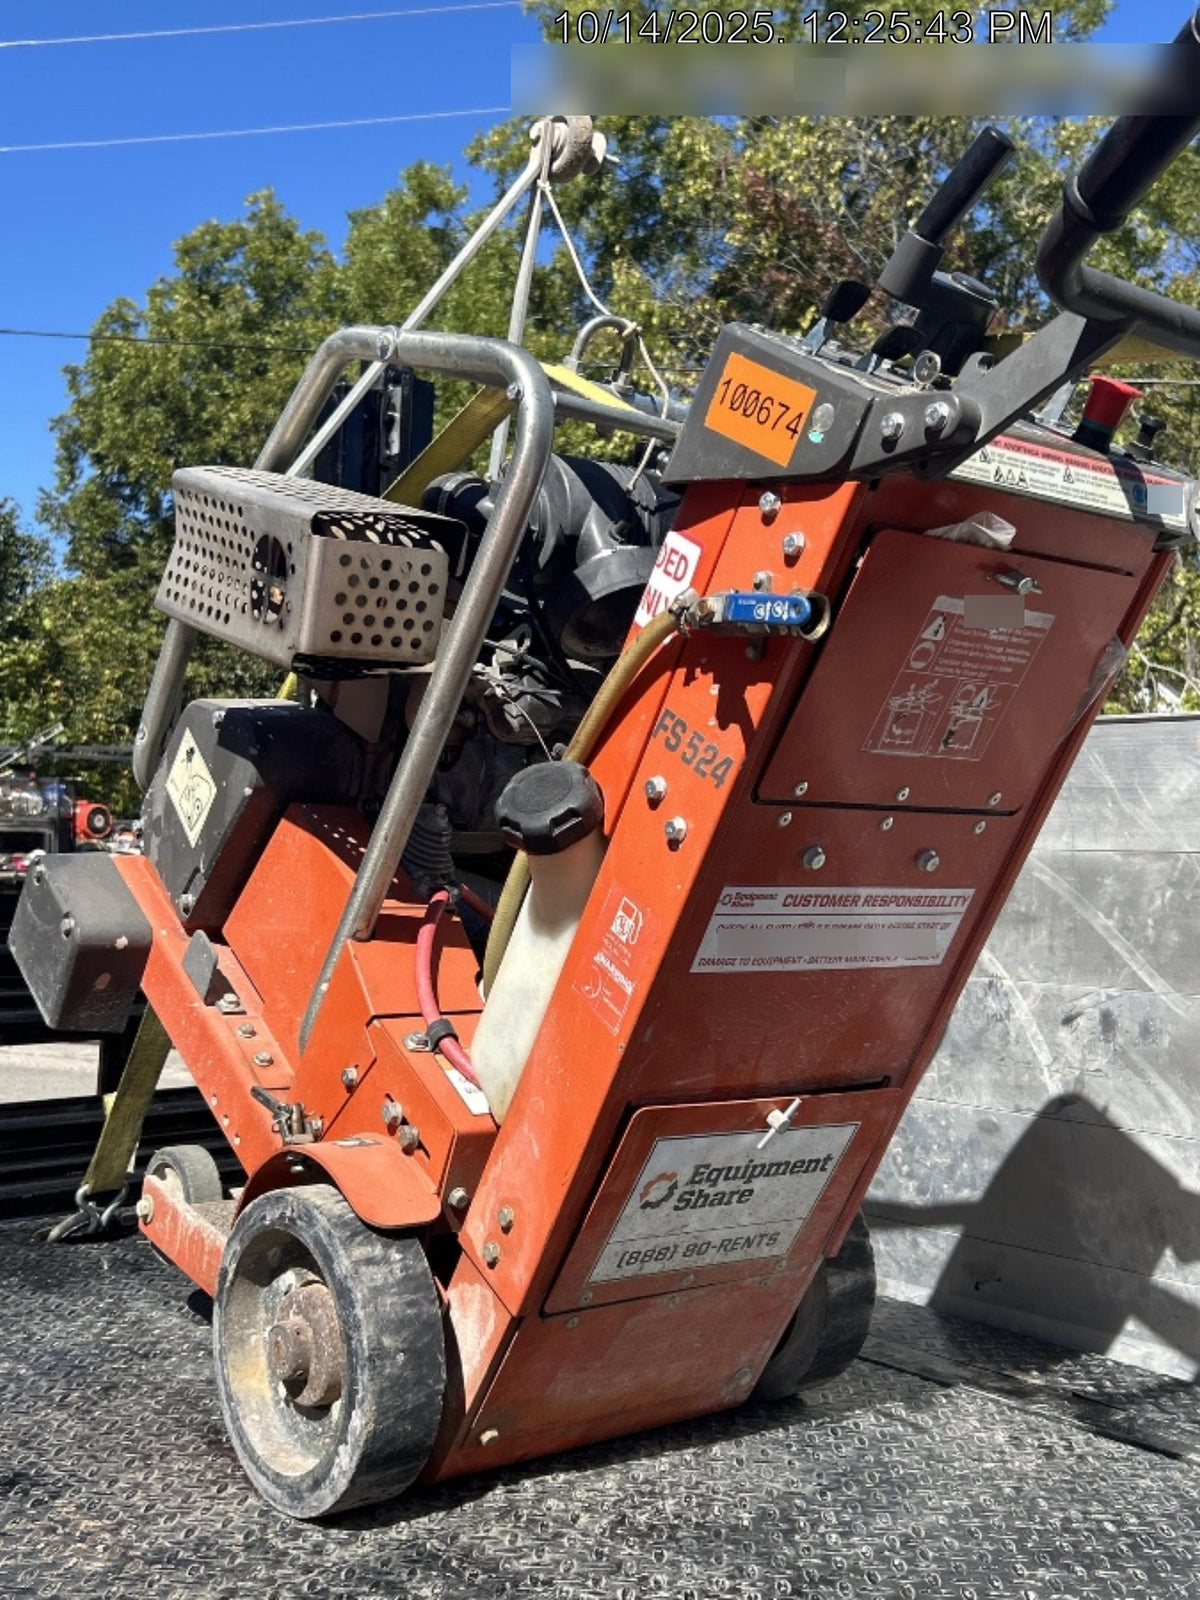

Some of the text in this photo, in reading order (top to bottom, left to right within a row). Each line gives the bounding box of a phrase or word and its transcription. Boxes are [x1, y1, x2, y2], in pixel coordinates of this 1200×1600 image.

[720, 378, 803, 439] 100674
[653, 708, 733, 789] FS 524
[782, 893, 970, 907] CUSTOMER RESPONSIBILITY
[687, 1153, 833, 1188] Equipment
[673, 1187, 754, 1211] Share
[616, 1232, 781, 1268] (888) 80-RENTS
